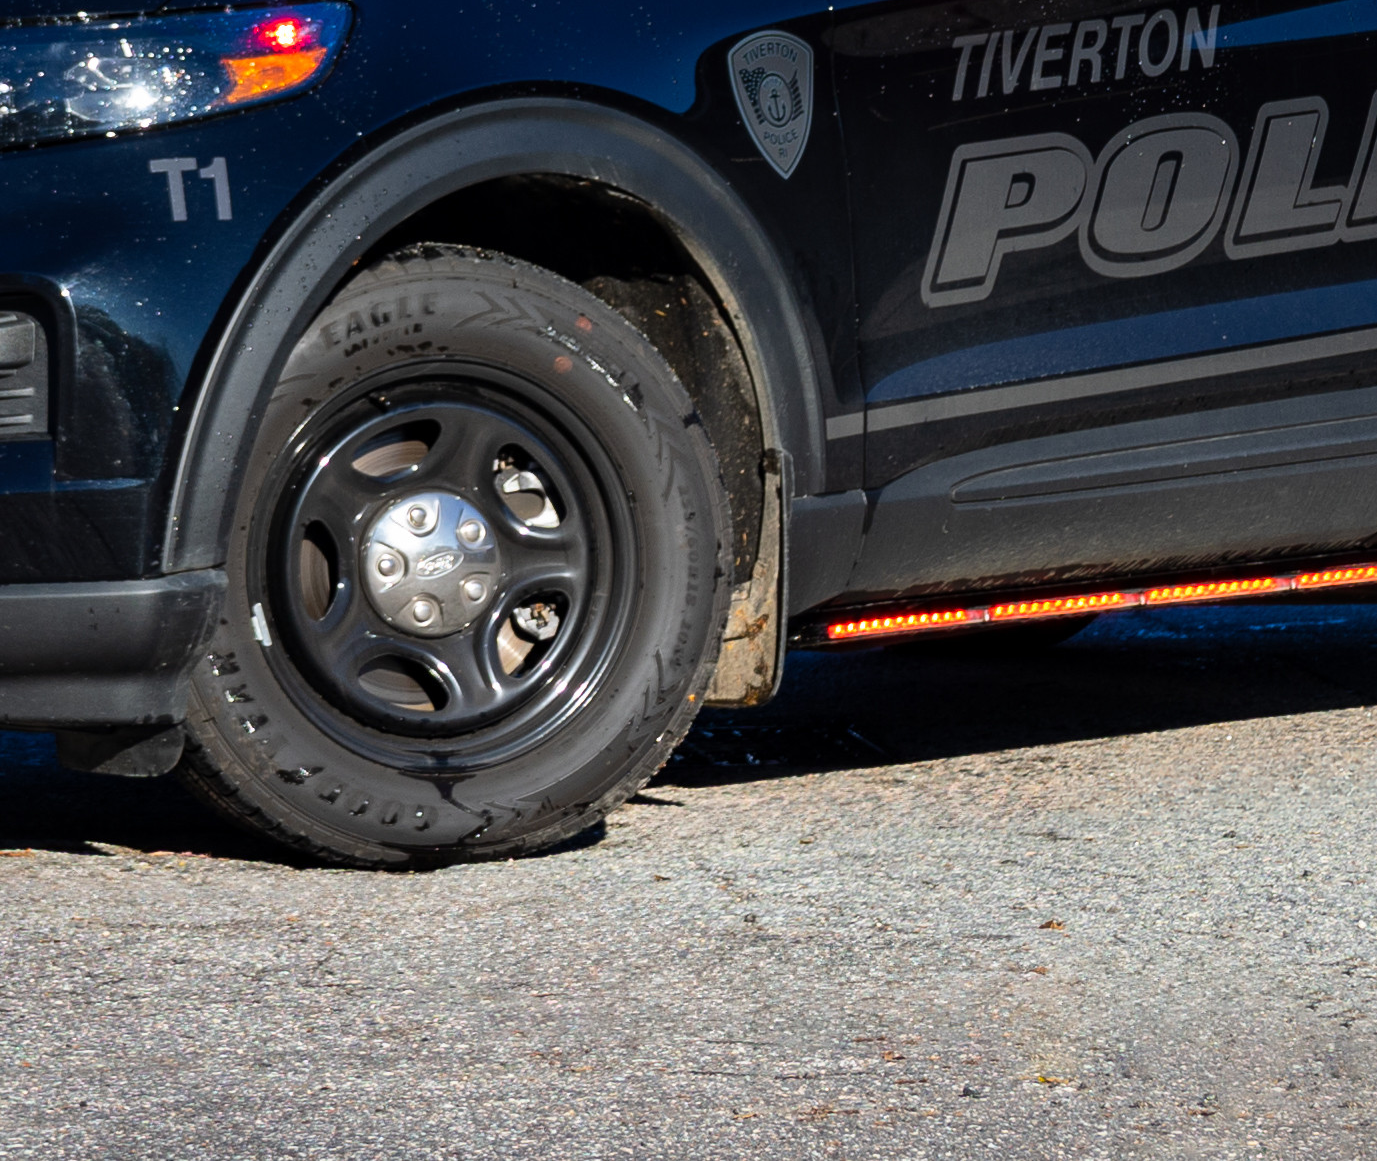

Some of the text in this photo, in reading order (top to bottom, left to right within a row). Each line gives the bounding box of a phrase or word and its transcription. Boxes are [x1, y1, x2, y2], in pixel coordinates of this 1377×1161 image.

[742, 41, 799, 65] TIVERTON
[952, 4, 1221, 101] TIVERTON
[763, 128, 799, 146] POLICE
[778, 148, 789, 159] RI
[149, 157, 232, 222] T1
[320, 292, 438, 350] EAGLE
